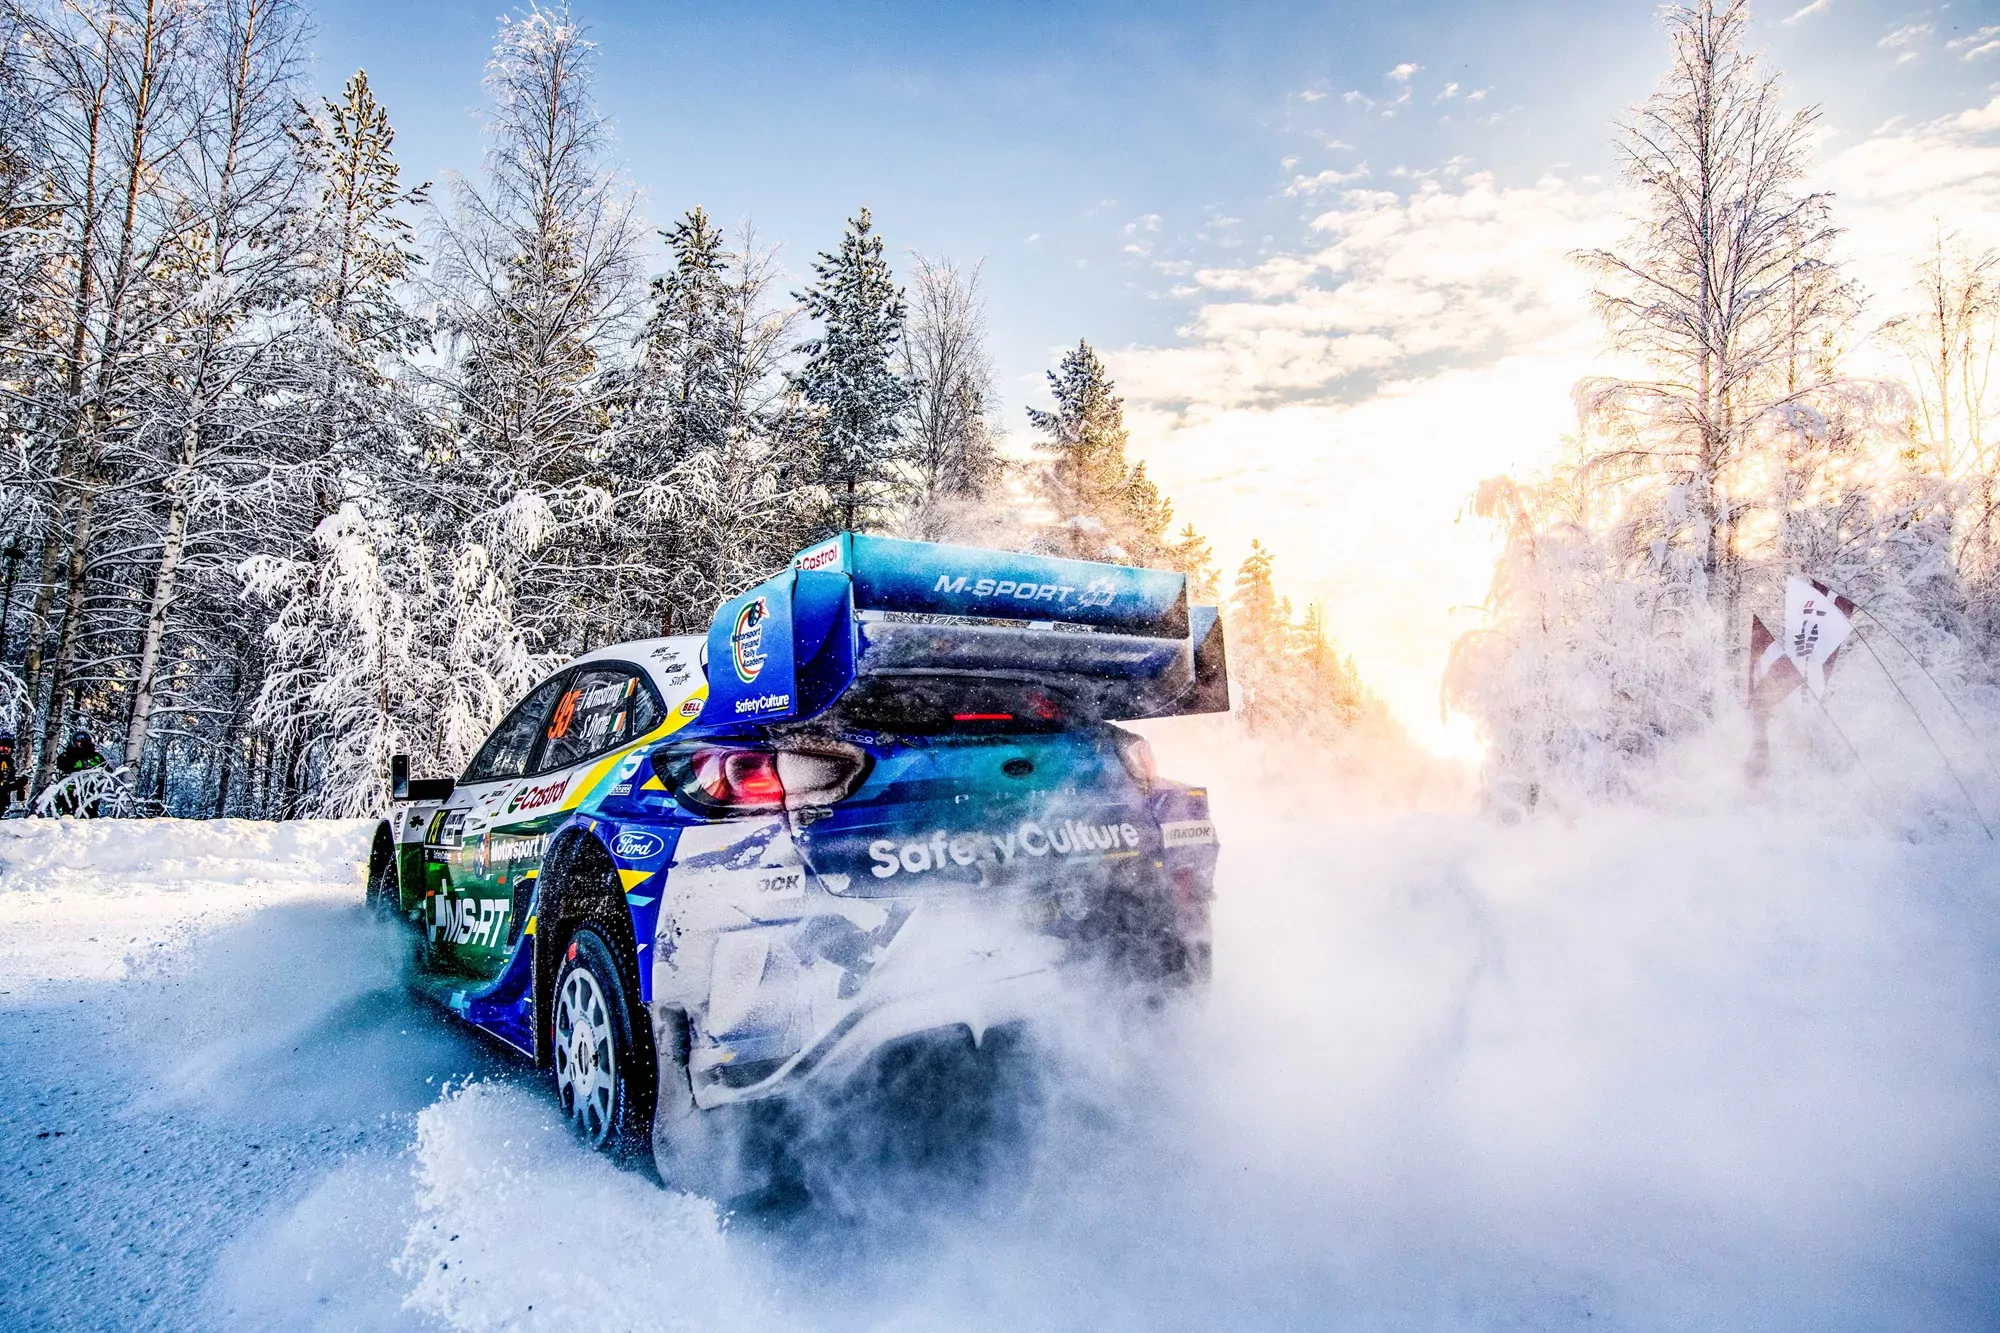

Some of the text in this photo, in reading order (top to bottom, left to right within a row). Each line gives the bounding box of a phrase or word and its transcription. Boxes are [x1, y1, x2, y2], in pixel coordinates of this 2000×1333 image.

[802, 545, 838, 570] Castrol
[932, 575, 1076, 602] M-SPORT
[732, 627, 761, 643] Motorsport
[741, 637, 760, 651] Ireland
[743, 649, 756, 659] Rally
[547, 681, 625, 740] 95 J Armstrong
[681, 703, 700, 711] BELL
[735, 694, 790, 714] SafetyCulture
[579, 712, 611, 742] S Byrne
[520, 773, 574, 811] Castrol
[490, 834, 540, 863] Motorsport
[616, 832, 653, 856] Ford
